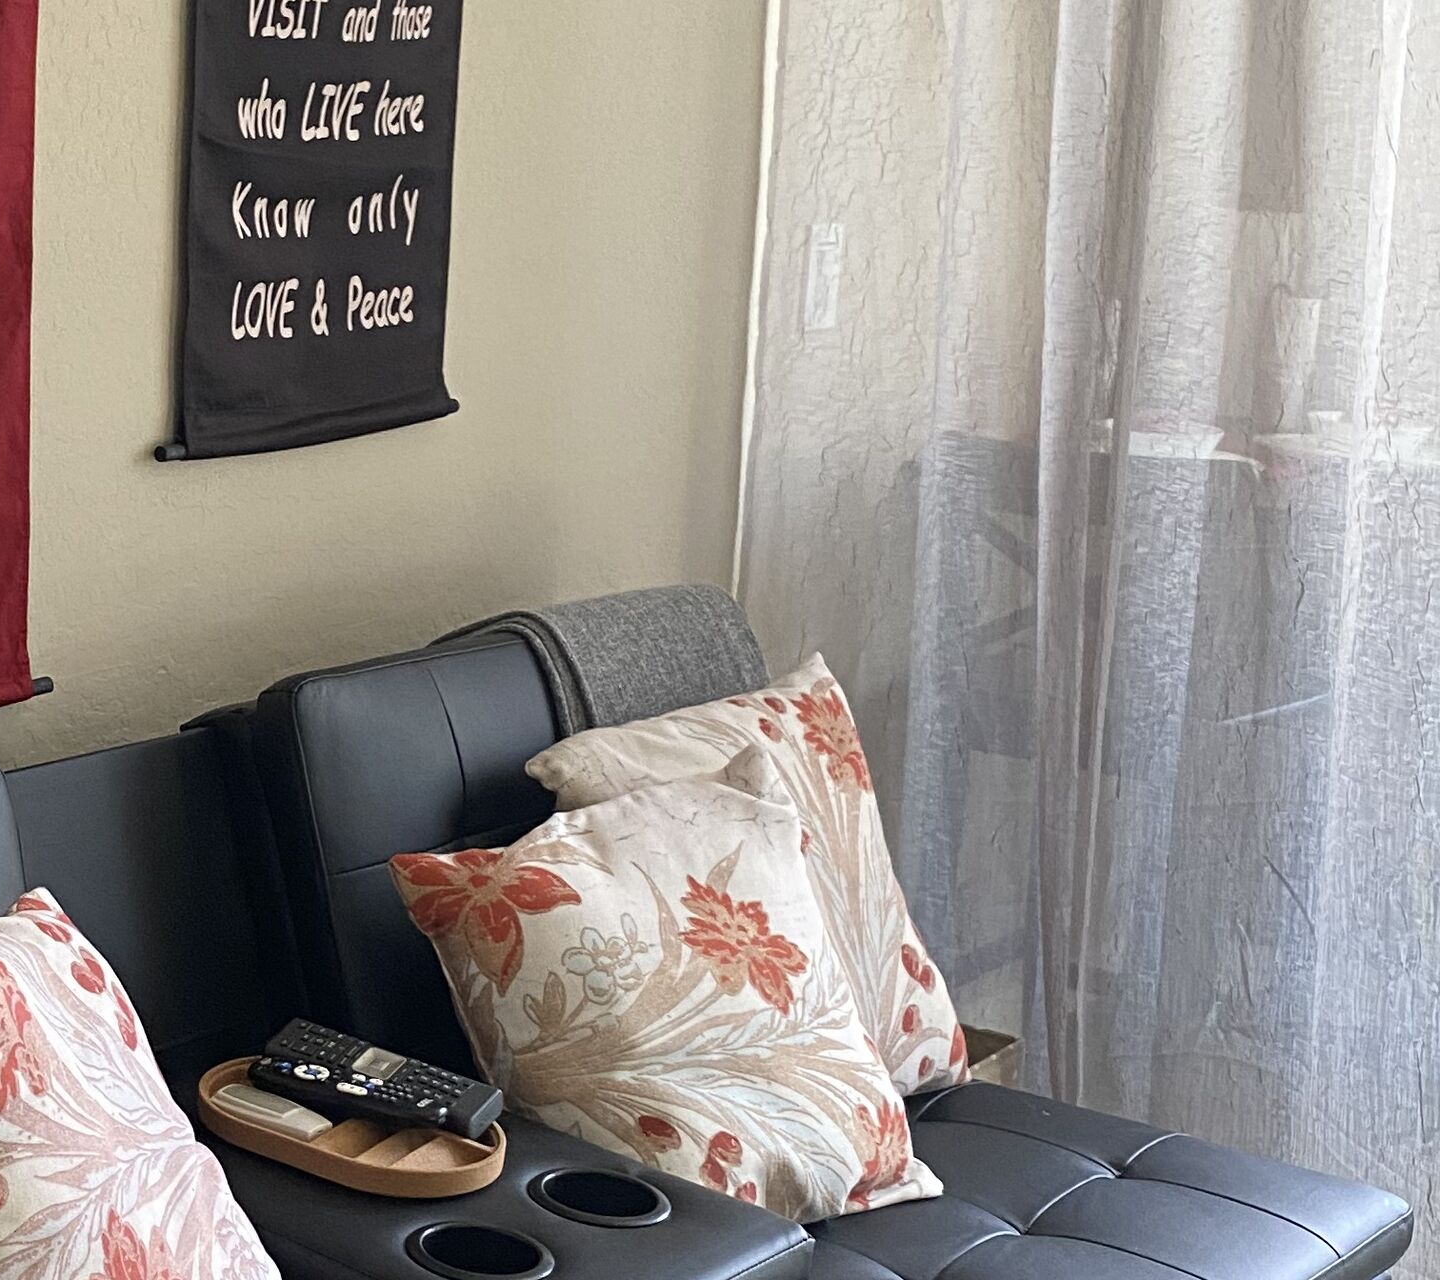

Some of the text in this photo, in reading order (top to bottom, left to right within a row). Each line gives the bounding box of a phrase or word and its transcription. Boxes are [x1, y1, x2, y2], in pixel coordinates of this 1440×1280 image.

[238, 78, 424, 141] who LIVE here
[233, 175, 418, 245] Know only
[232, 276, 413, 340] LOVE & Peace
